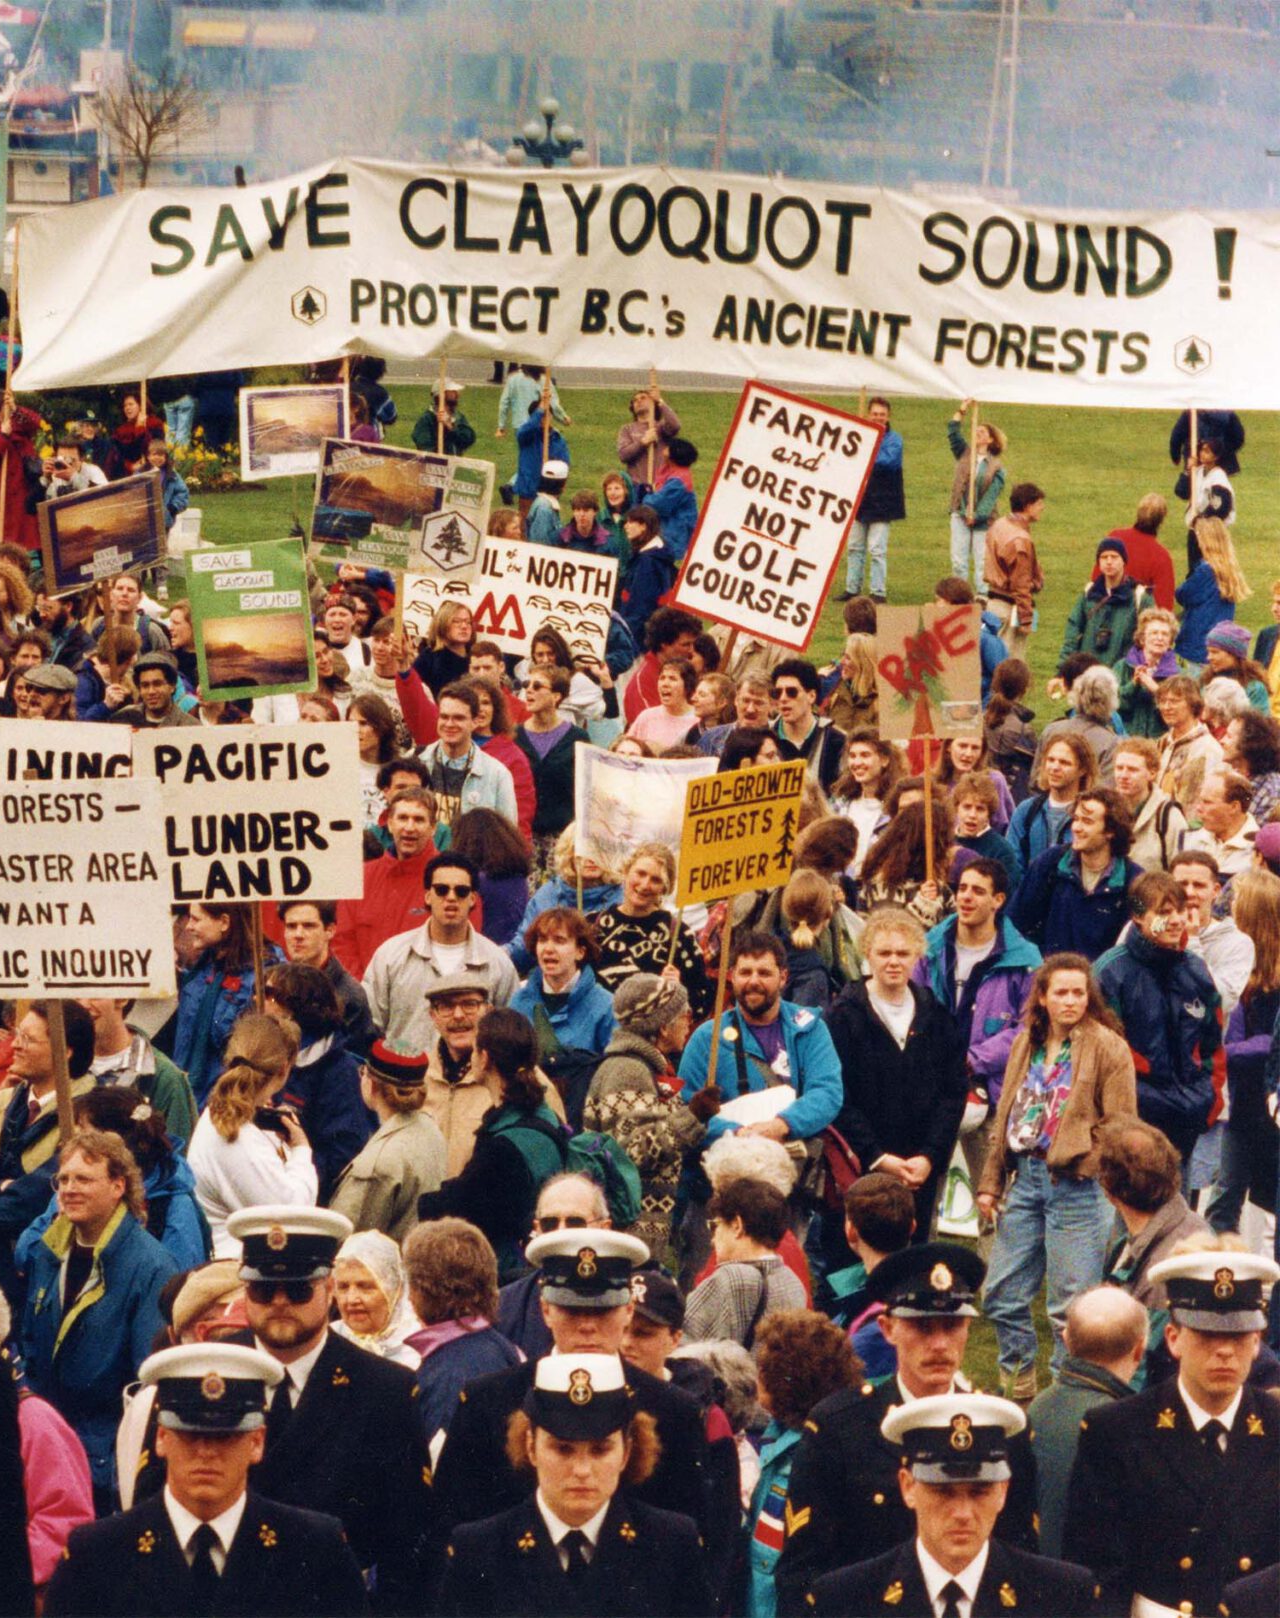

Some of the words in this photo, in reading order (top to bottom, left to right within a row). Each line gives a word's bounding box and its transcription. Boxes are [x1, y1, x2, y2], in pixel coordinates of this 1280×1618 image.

[148, 172, 351, 276] SAVE
[399, 177, 873, 277] CLAYOQUOT
[919, 211, 1173, 299] SOUND
[350, 277, 560, 335] PROTECT
[712, 294, 912, 358] ANCIENT
[934, 318, 1151, 375] FORESTS
[748, 395, 863, 458] FARMS
[771, 445, 825, 473] and
[723, 456, 853, 525] FORESTS
[743, 502, 812, 547] NOT
[200, 553, 244, 570] SAVE
[526, 555, 612, 599] NORTH
[712, 529, 818, 587] GOLF
[241, 592, 300, 609] SOUND
[684, 561, 812, 628] COURSES
[878, 604, 977, 702] RAPE
[154, 742, 331, 785] PACIFIC
[690, 766, 805, 811] OLD-GROWTH
[694, 807, 774, 846] FORESTS
[86, 850, 159, 884] AREA
[171, 856, 313, 900] LAND
[688, 852, 770, 894] FOREVER
[78, 901, 96, 926] A
[41, 947, 154, 980] INQUIRY
